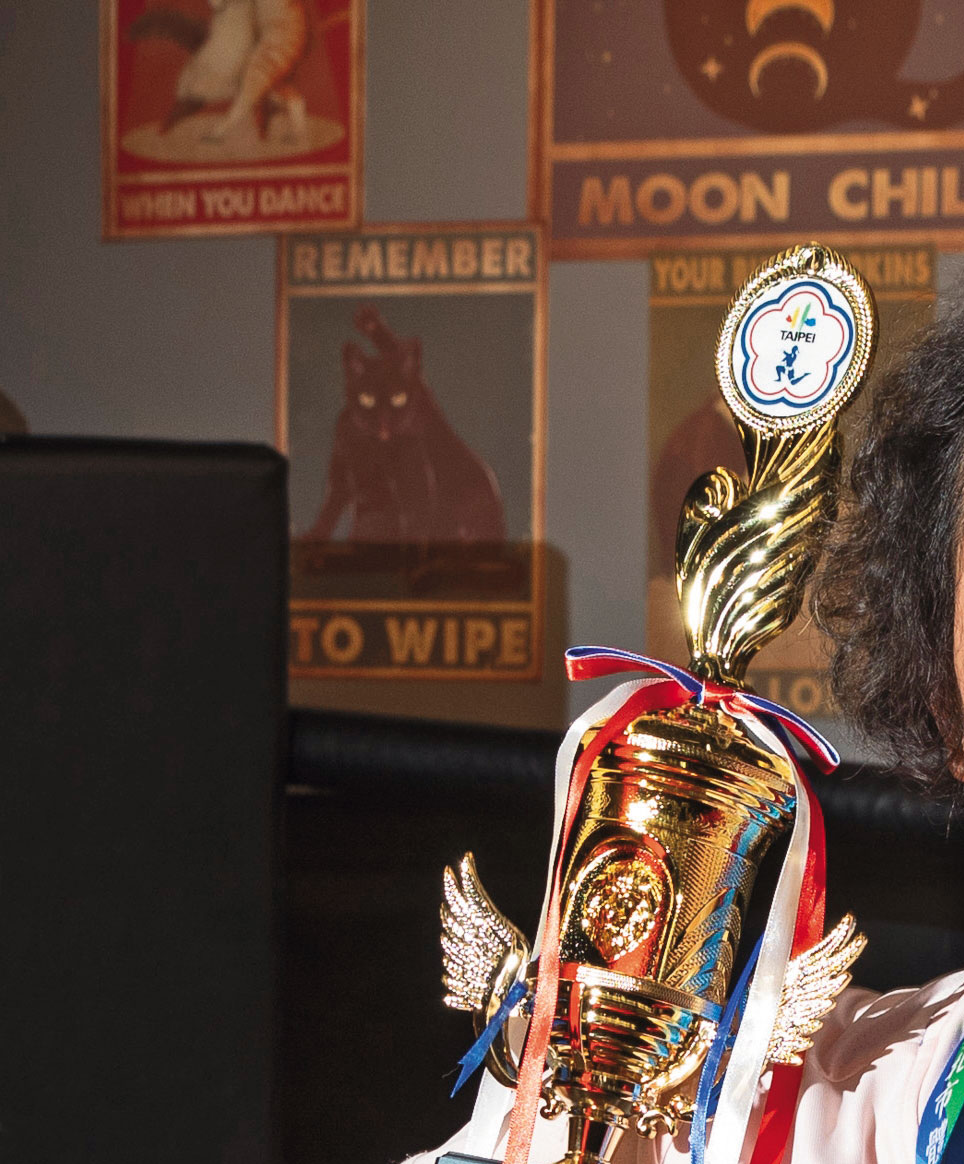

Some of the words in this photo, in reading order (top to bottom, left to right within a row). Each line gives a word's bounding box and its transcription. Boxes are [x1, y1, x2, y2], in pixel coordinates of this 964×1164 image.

[201, 187, 255, 218] YOU
[259, 183, 346, 216] DANCE
[577, 172, 792, 227] MOON
[290, 238, 532, 280] REMEMBER
[654, 255, 724, 291] YOUR
[780, 330, 816, 344] TAIPEI
[289, 615, 365, 664] TO
[385, 616, 528, 665] WIPE
